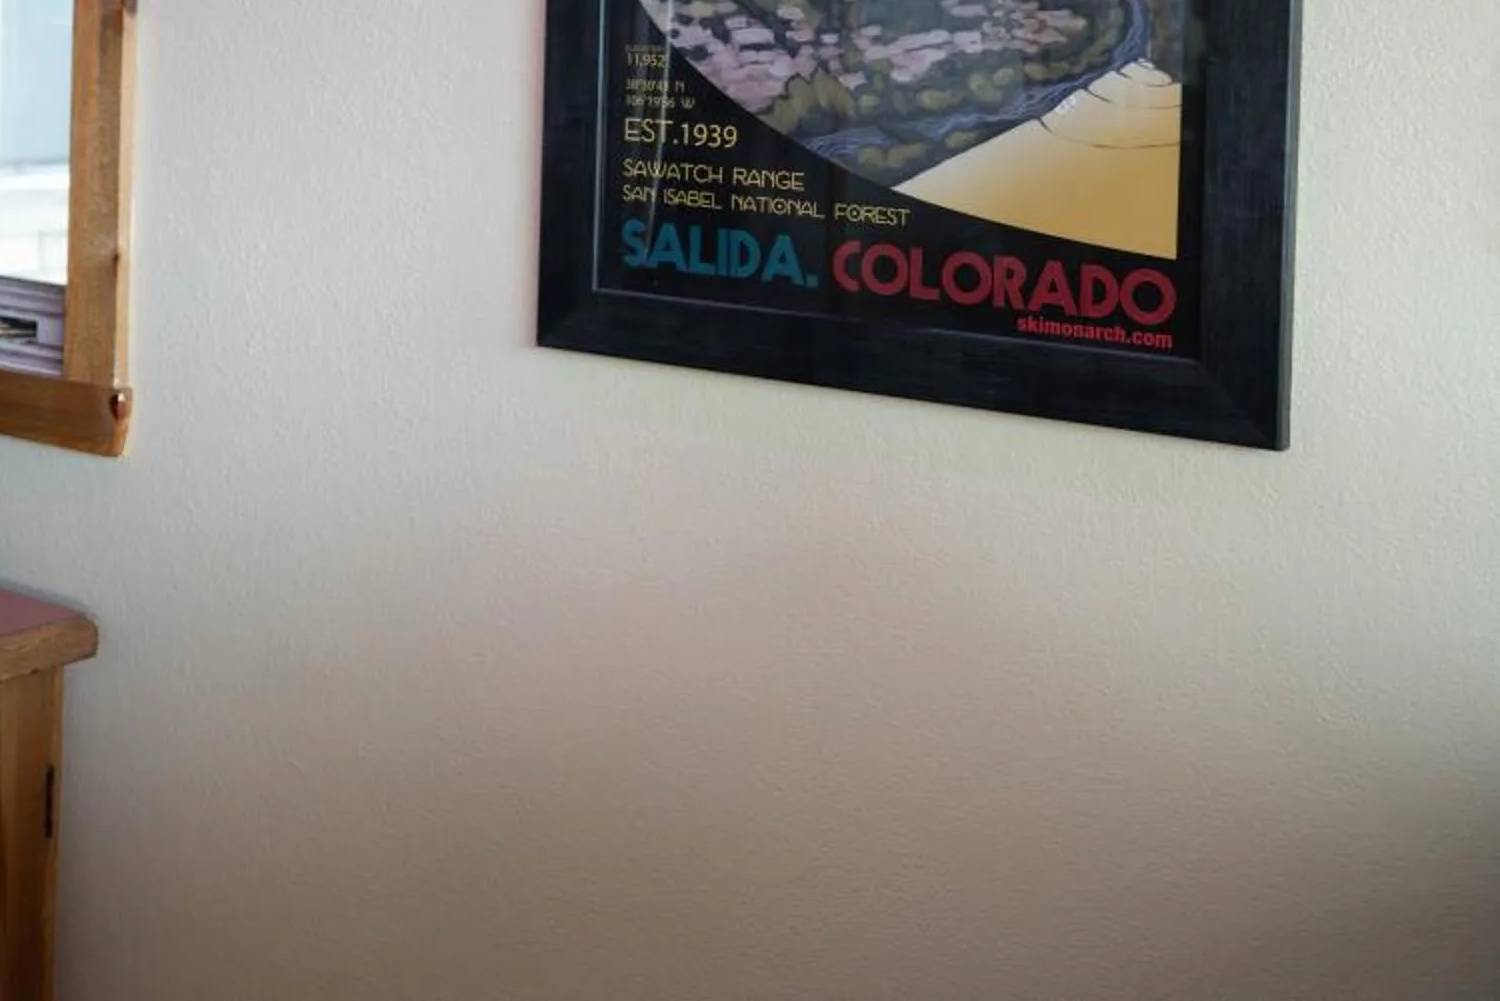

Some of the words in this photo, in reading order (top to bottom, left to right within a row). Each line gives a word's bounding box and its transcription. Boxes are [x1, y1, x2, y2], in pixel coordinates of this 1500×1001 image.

[624, 117, 738, 148] EST.1939
[622, 158, 723, 184] SAWATCH
[732, 166, 805, 192] RANGE
[622, 184, 656, 202] SAN
[663, 188, 723, 210] ISABEL
[731, 194, 825, 220] NATIONAL
[834, 202, 912, 227] FOREST
[833, 240, 1177, 325] COLORADO
[1017, 315, 1173, 349] skimonarch.com
